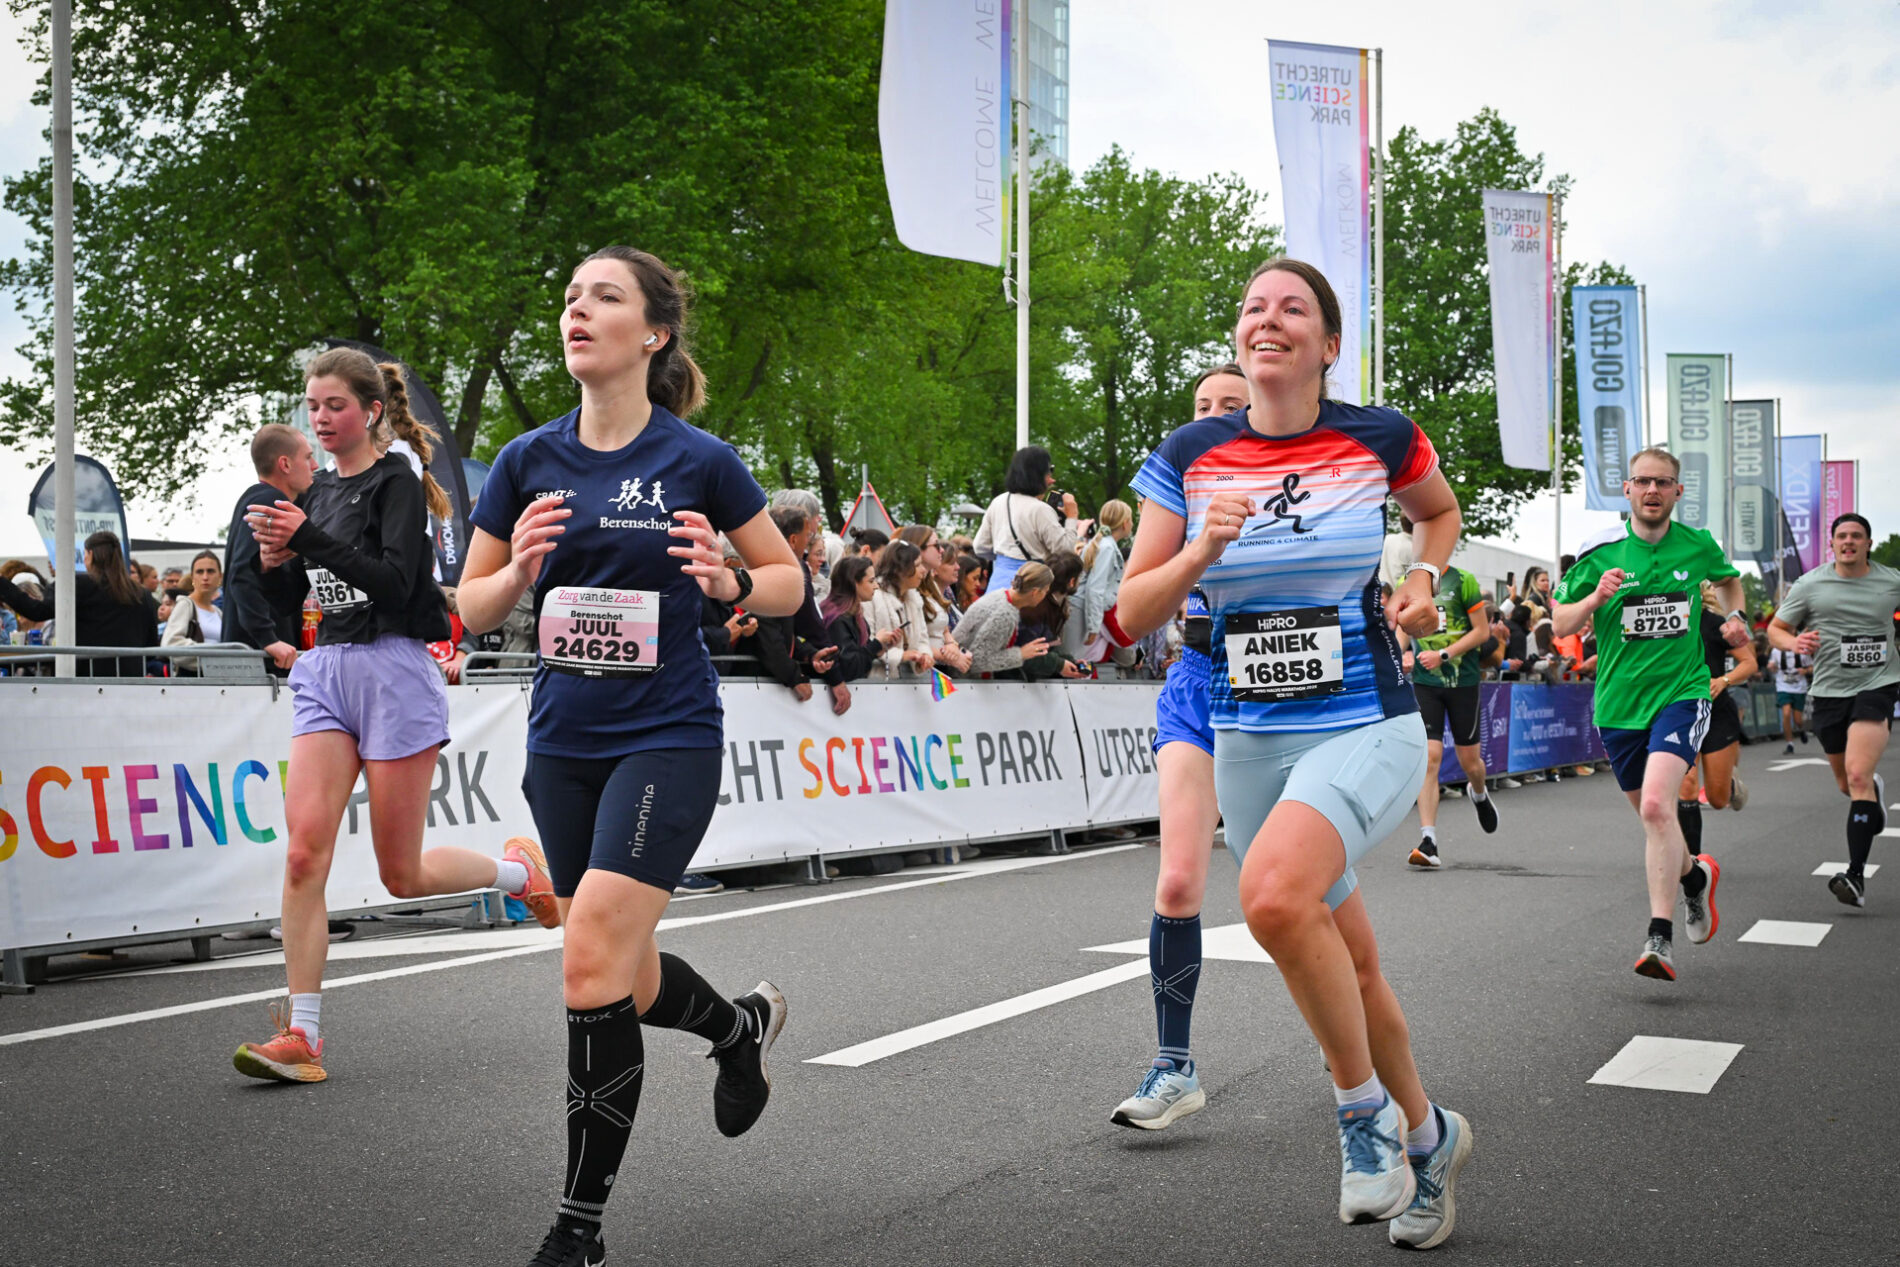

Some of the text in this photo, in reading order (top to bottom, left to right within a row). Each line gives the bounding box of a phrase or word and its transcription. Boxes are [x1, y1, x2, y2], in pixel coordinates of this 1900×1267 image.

[599, 517, 672, 531] Berenschot
[1238, 539, 1275, 548] RUNNING
[1284, 535, 1319, 545] CLIMATE
[316, 584, 356, 605] 5361
[558, 589, 643, 604] Zorg van de Zaak
[570, 610, 623, 621] Berenschot
[1637, 605, 1676, 617] PHILIP
[569, 619, 623, 637] JUUL
[1634, 615, 1681, 632] 8720
[553, 636, 639, 662] 24629
[1244, 632, 1320, 656] ANIEK
[1847, 651, 1881, 662] 8560
[1244, 658, 1324, 685] 16858
[1092, 726, 1159, 778] UTREC
[798, 733, 971, 800] SCIENCE
[975, 729, 1063, 787] PARK
[0, 750, 501, 863] CIENC PRK
